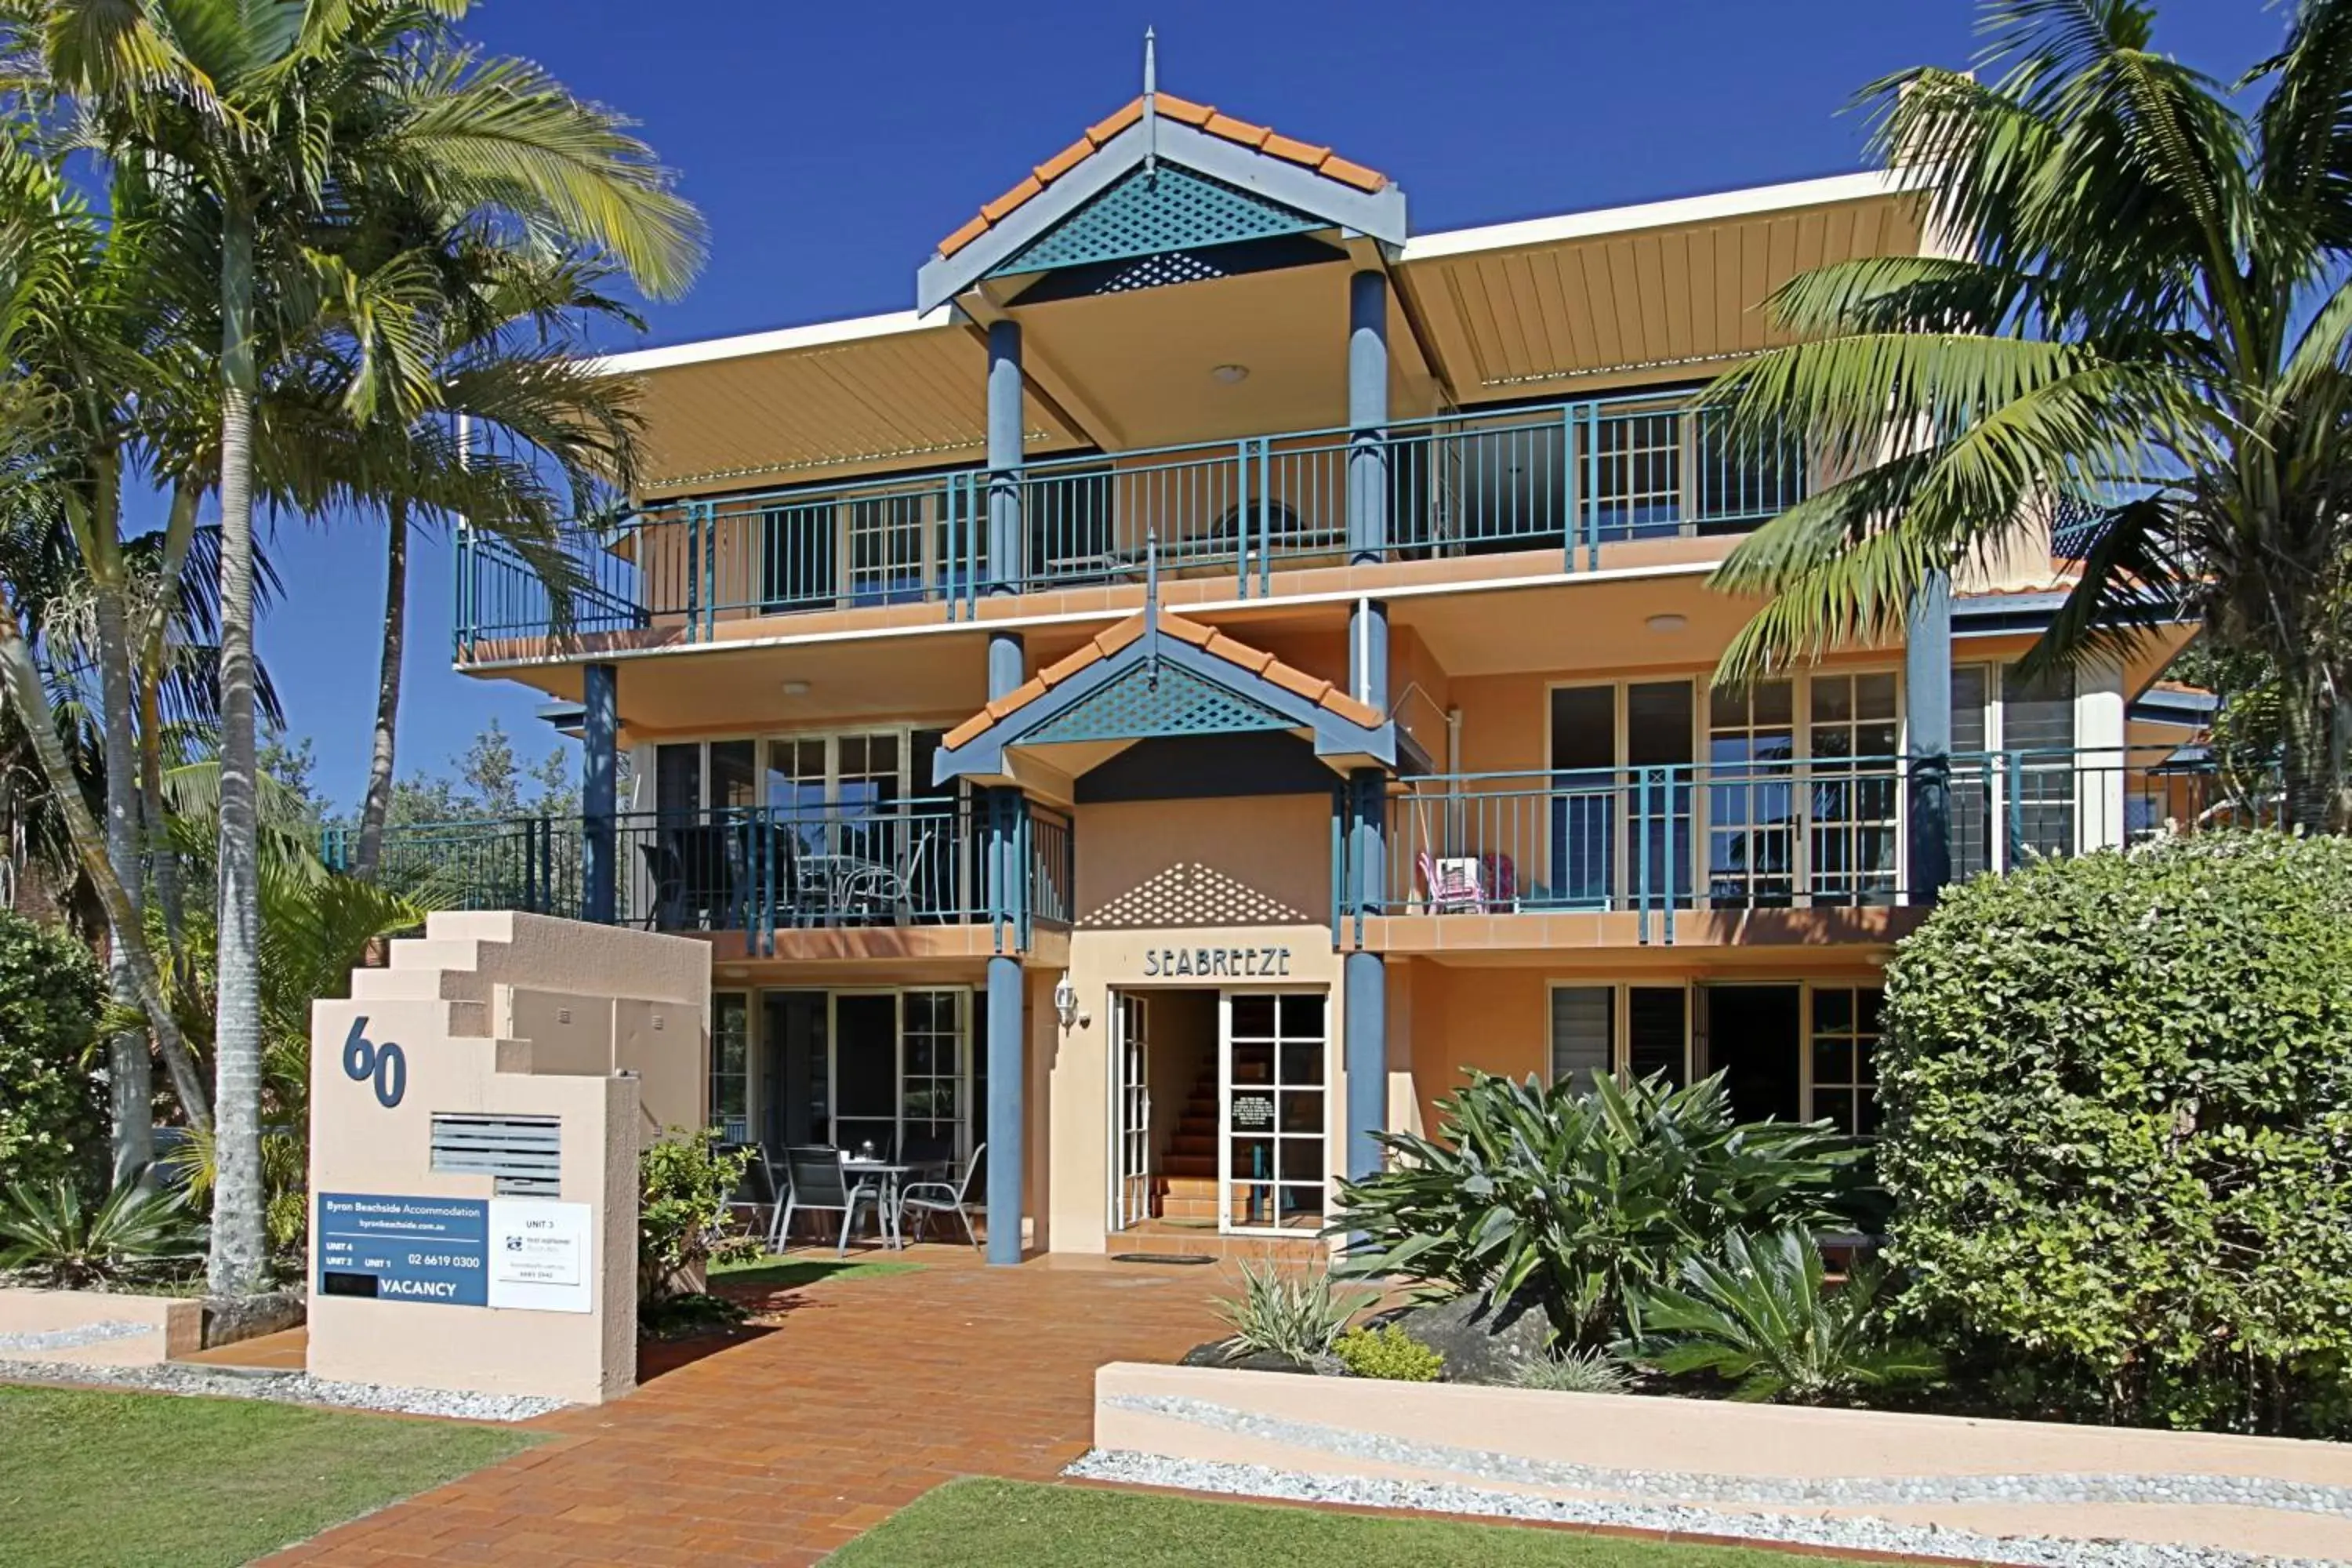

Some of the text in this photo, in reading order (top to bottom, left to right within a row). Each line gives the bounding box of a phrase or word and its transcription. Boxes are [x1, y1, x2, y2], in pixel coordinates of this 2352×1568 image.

[1143, 946, 1291, 976] SEABREEZE
[343, 1016, 407, 1108] 60
[326, 1200, 480, 1218] Byron Beachside Accommodation
[358, 1219, 445, 1231] byronbeachside.com.au
[526, 1220, 546, 1229] UNIT
[326, 1243, 345, 1251] UNIT
[326, 1257, 345, 1265] UNIT
[365, 1258, 383, 1268] UNIT
[408, 1254, 480, 1268] 02 6619 0300
[380, 1279, 456, 1297] VACANCY
